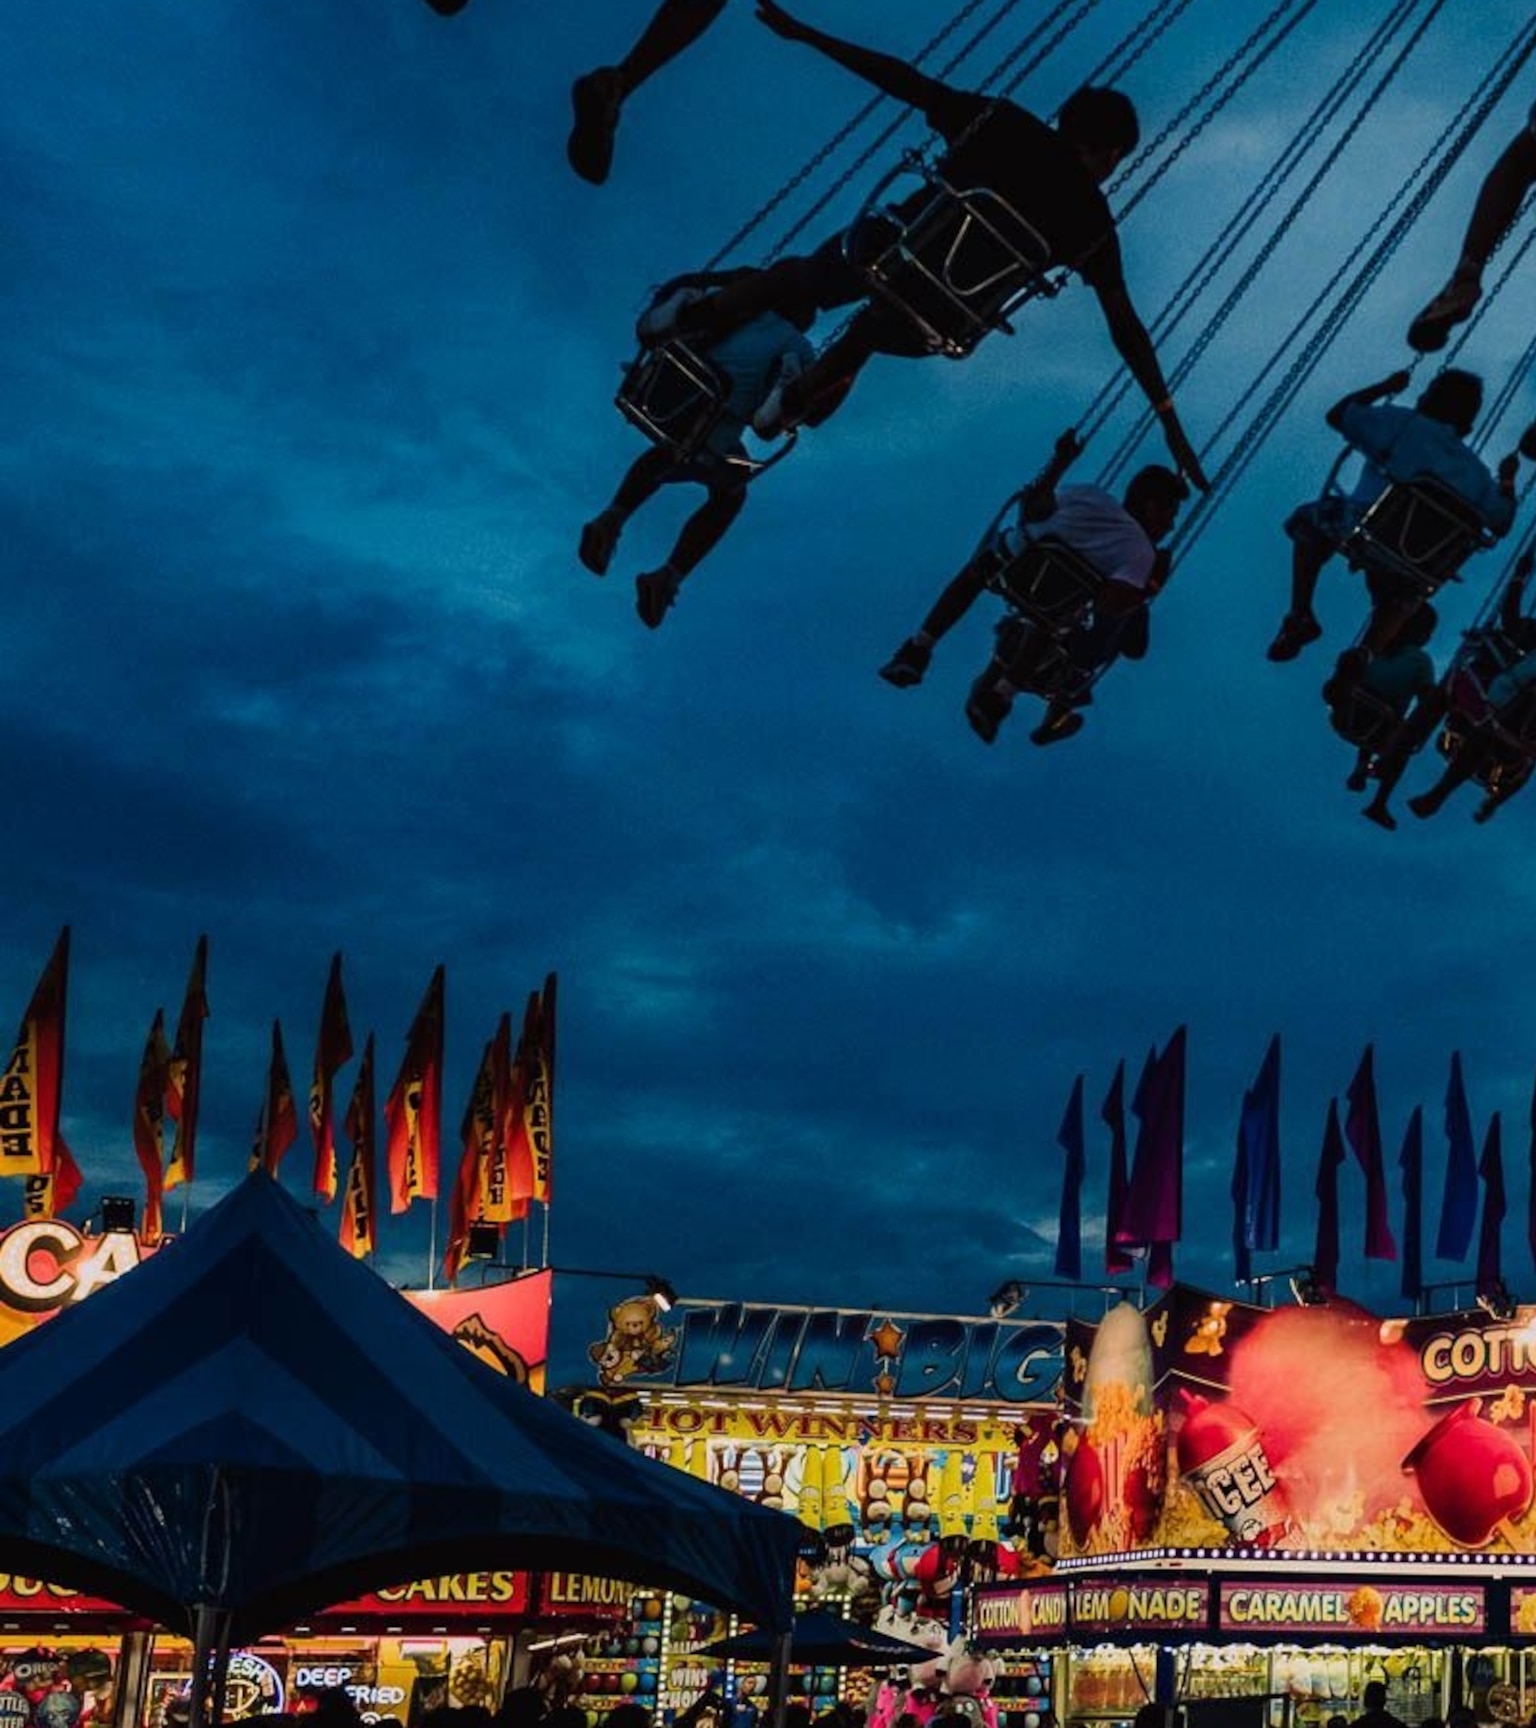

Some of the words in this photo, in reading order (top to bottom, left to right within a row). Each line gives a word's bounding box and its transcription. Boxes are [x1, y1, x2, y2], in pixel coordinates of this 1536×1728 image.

[674, 1303, 873, 1392] WIN
[894, 1319, 1066, 1401] BIG
[745, 1409, 979, 1444] WINNERS
[980, 1600, 1019, 1629] COTTON
[1229, 1591, 1350, 1623] CARAMEL
[1384, 1595, 1477, 1625] APPLES
[296, 1667, 350, 1688] DEEP
